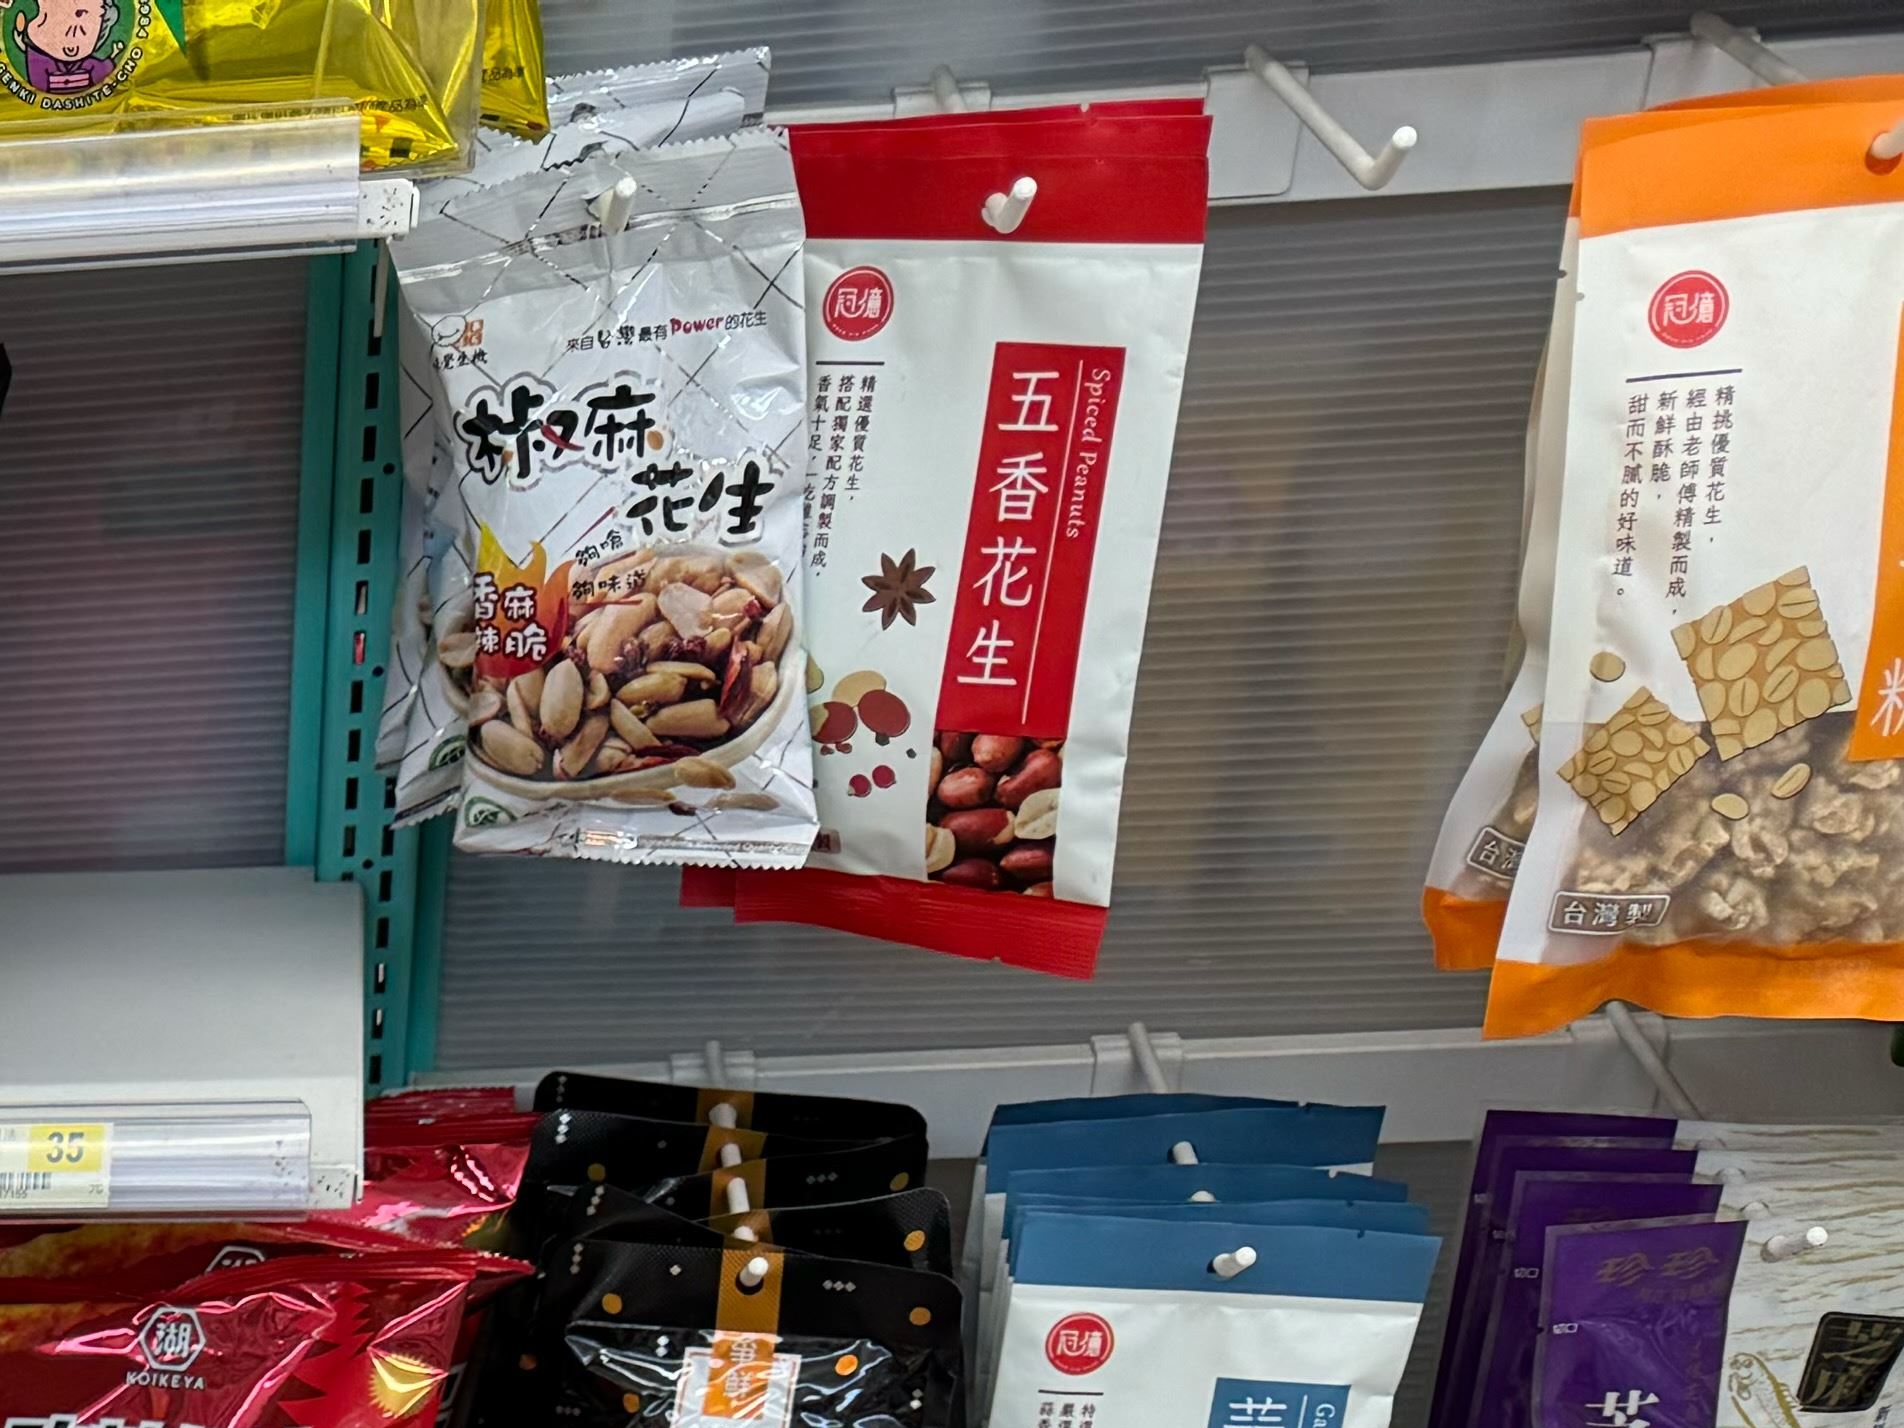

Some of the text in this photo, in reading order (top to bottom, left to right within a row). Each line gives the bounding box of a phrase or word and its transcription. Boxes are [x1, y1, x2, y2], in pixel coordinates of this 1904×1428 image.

[462, 384, 664, 482] 椒麻
[1065, 368, 1112, 538] Spiced Peanuts
[627, 459, 777, 537] 花生
[957, 370, 1061, 687] 五香花生
[1611, 394, 1650, 596] 甜而不膩的好味道。
[1563, 900, 1654, 927] 台灣製
[46, 1132, 84, 1162] 35
[125, 1371, 206, 1390] KOIKEYA
